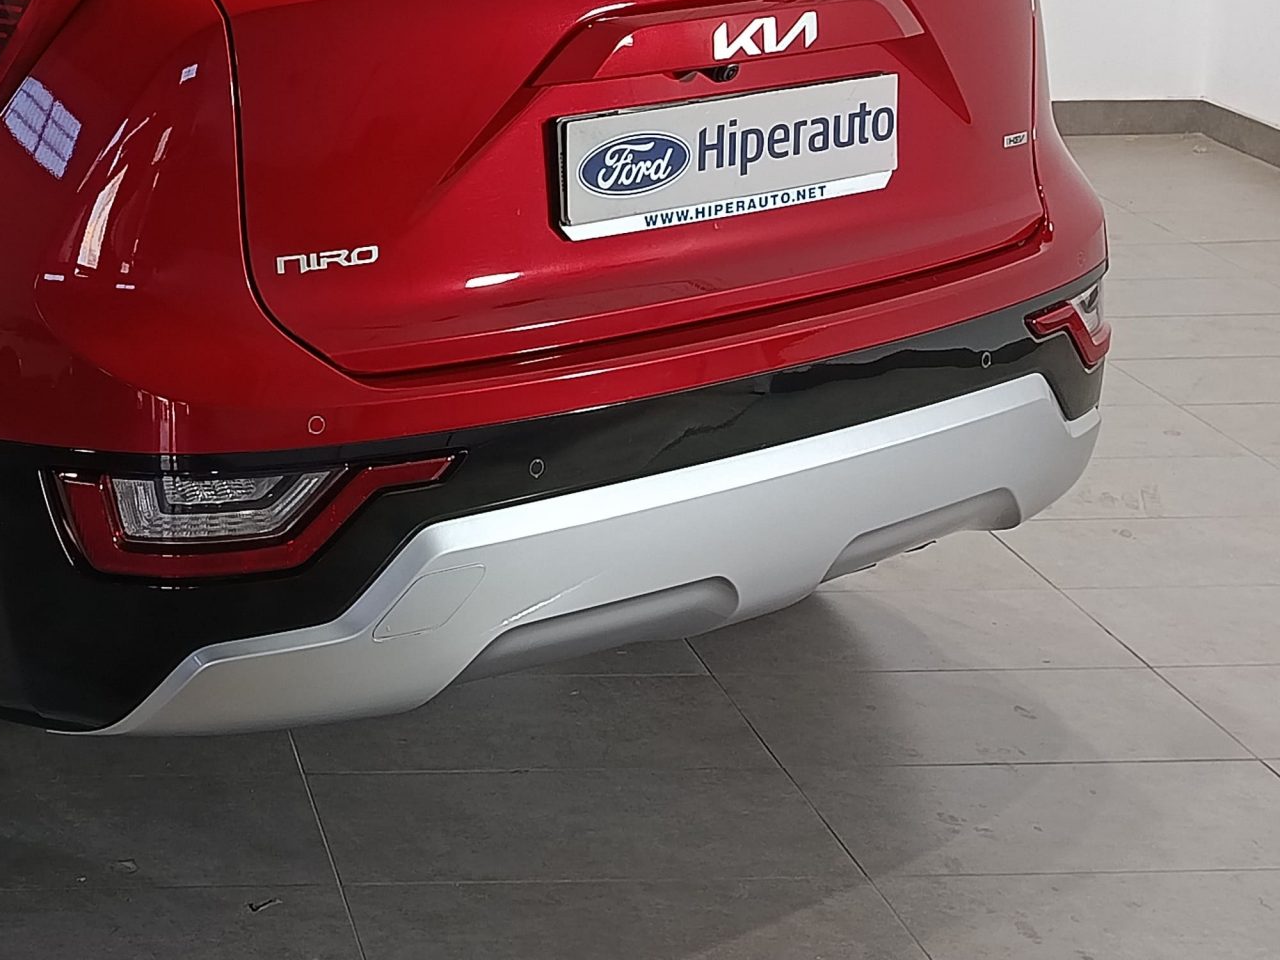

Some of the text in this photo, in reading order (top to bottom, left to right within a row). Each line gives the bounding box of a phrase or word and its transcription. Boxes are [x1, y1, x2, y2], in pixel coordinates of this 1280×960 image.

[713, 11, 818, 61] KIA
[597, 141, 672, 188] Ford
[697, 102, 895, 176] Hiperauto
[644, 185, 827, 227] WWW.HIPERAUTO.NET
[276, 245, 379, 274] NIRO
